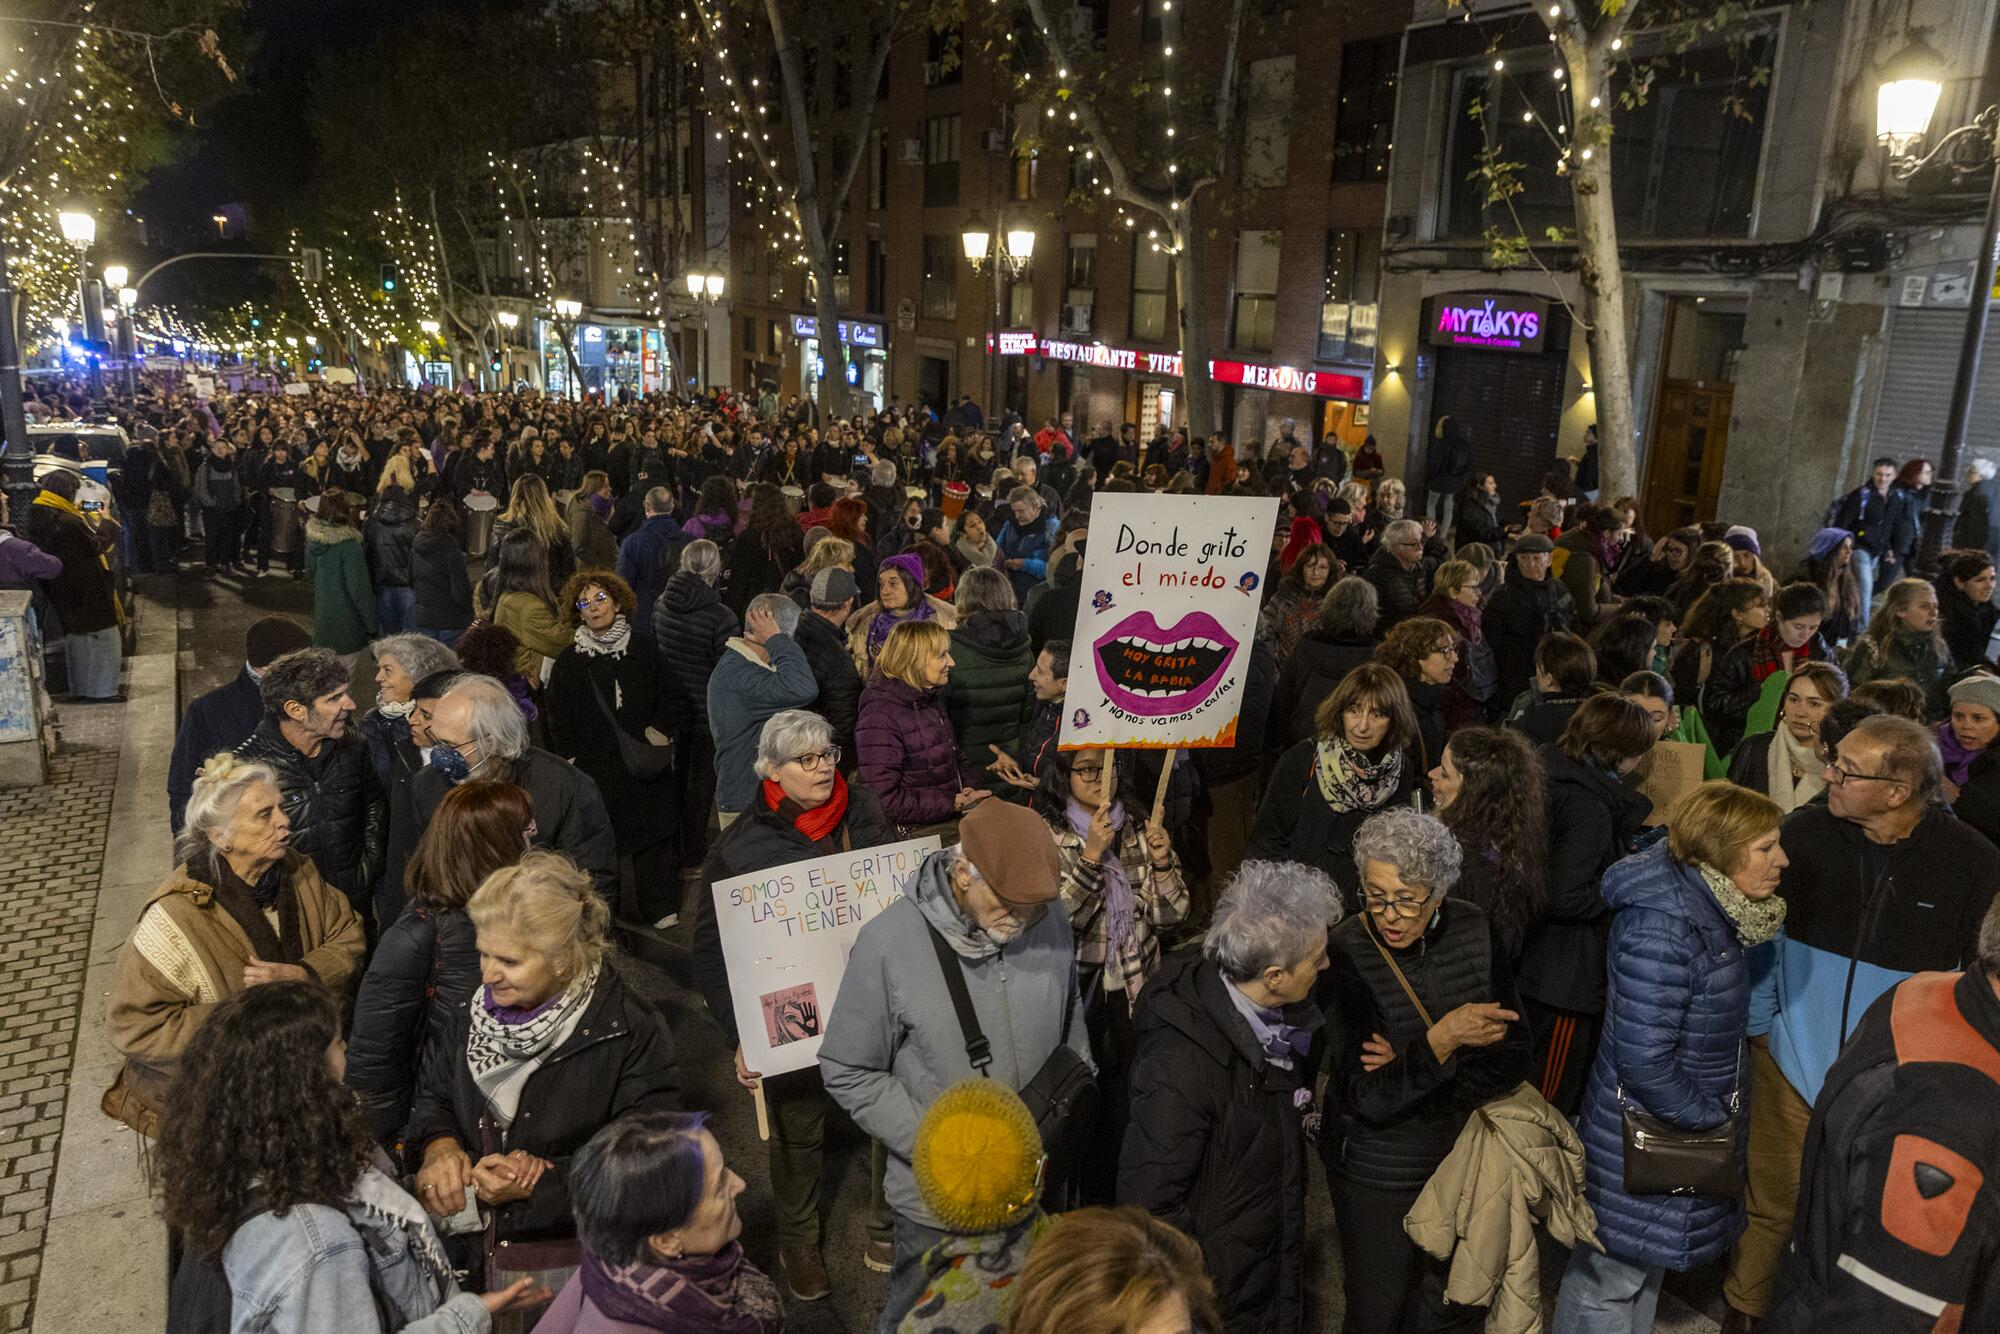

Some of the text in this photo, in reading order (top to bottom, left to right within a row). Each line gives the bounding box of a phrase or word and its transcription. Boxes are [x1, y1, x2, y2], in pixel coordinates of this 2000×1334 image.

[1438, 300, 1538, 338] MYTAKYS
[1049, 342, 1136, 369] RESTAURANTE
[1241, 364, 1317, 392] MEKONG
[1115, 523, 1248, 564] Donde gritó
[1122, 562, 1226, 589] el miedo
[1123, 648, 1197, 669] HOY GRITA
[1124, 669, 1194, 687] LA RABIA
[1108, 705, 1124, 719] NO
[1125, 714, 1146, 725] nos
[1151, 711, 1193, 725] vamos
[1195, 706, 1205, 715] a
[730, 875, 795, 907] SOMOS
[807, 867, 836, 888] EL
[751, 898, 788, 923] LAS
[805, 884, 848, 910] QUE
[856, 878, 878, 899] YA
